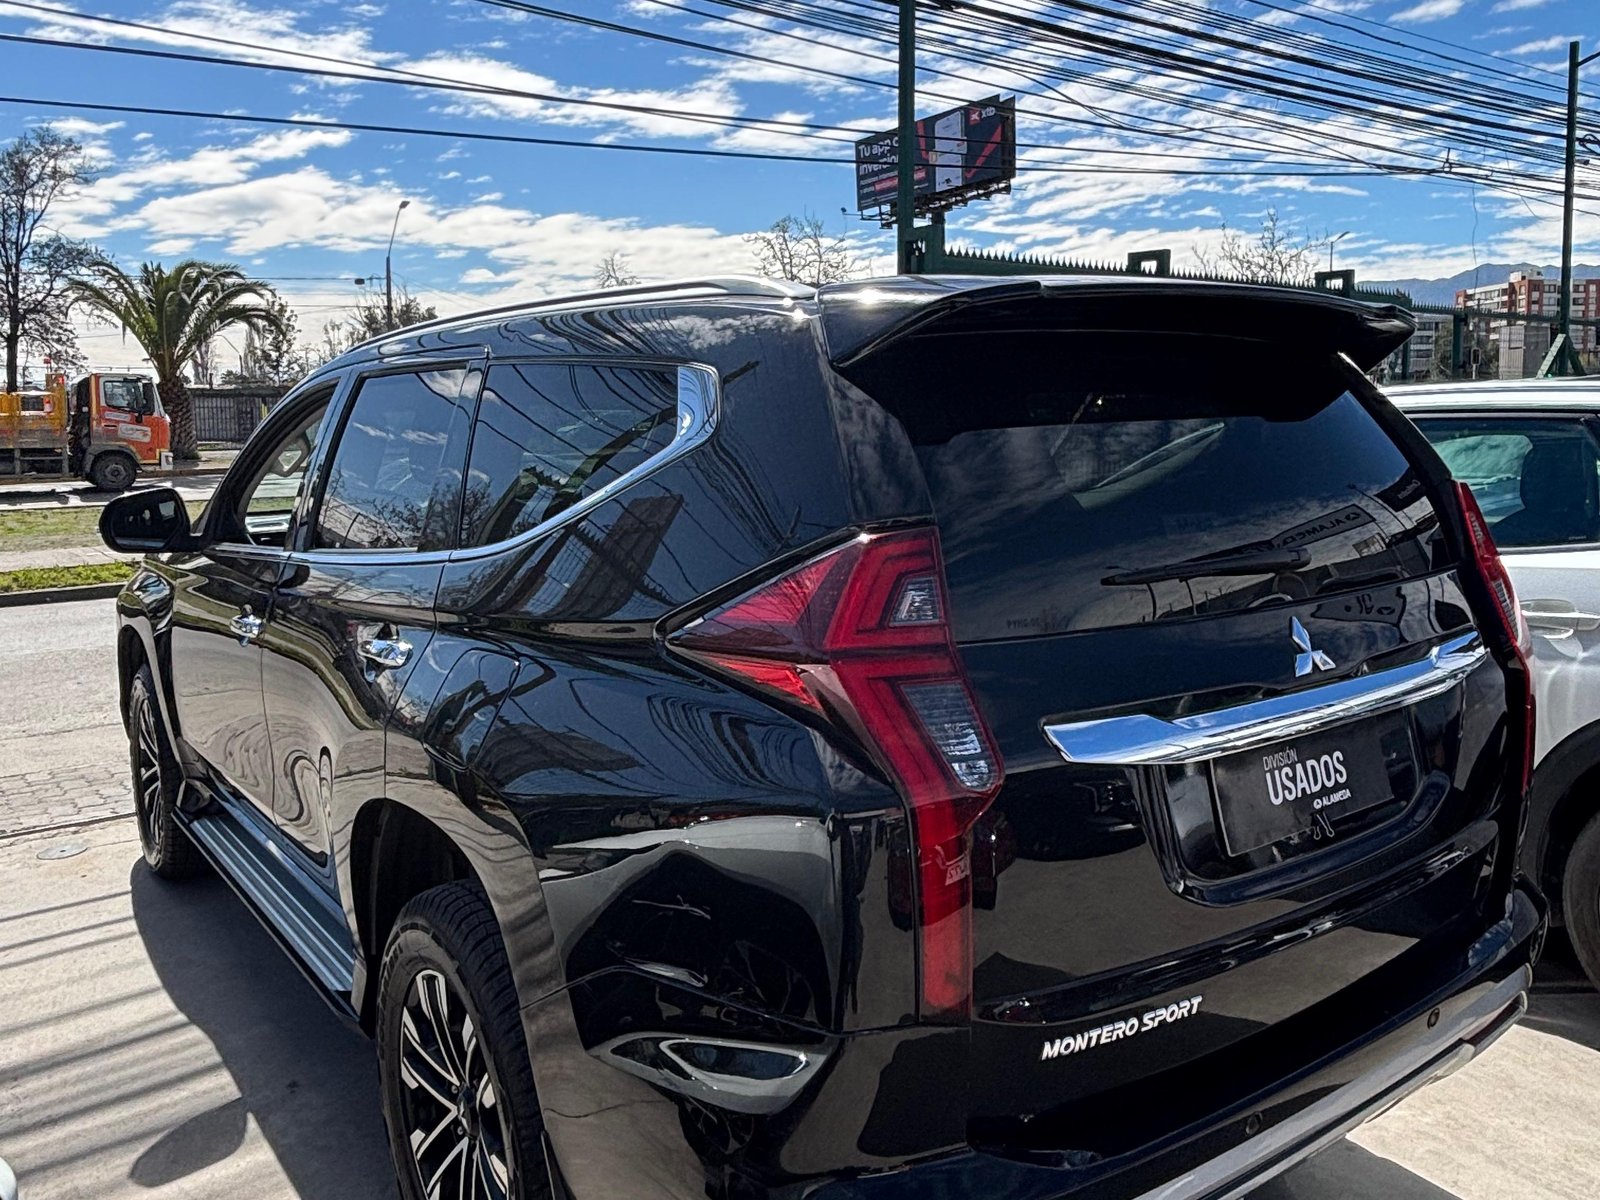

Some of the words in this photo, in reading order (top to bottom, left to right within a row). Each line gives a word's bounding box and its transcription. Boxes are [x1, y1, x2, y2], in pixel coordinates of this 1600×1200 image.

[858, 144, 871, 158] Tu
[1263, 747, 1298, 770] DIVISIÓN
[1265, 750, 1348, 806] USADOS
[1322, 788, 1352, 807] ALAMEDA
[1041, 1017, 1139, 1061] MONTERO
[1140, 995, 1203, 1032] SPORT
